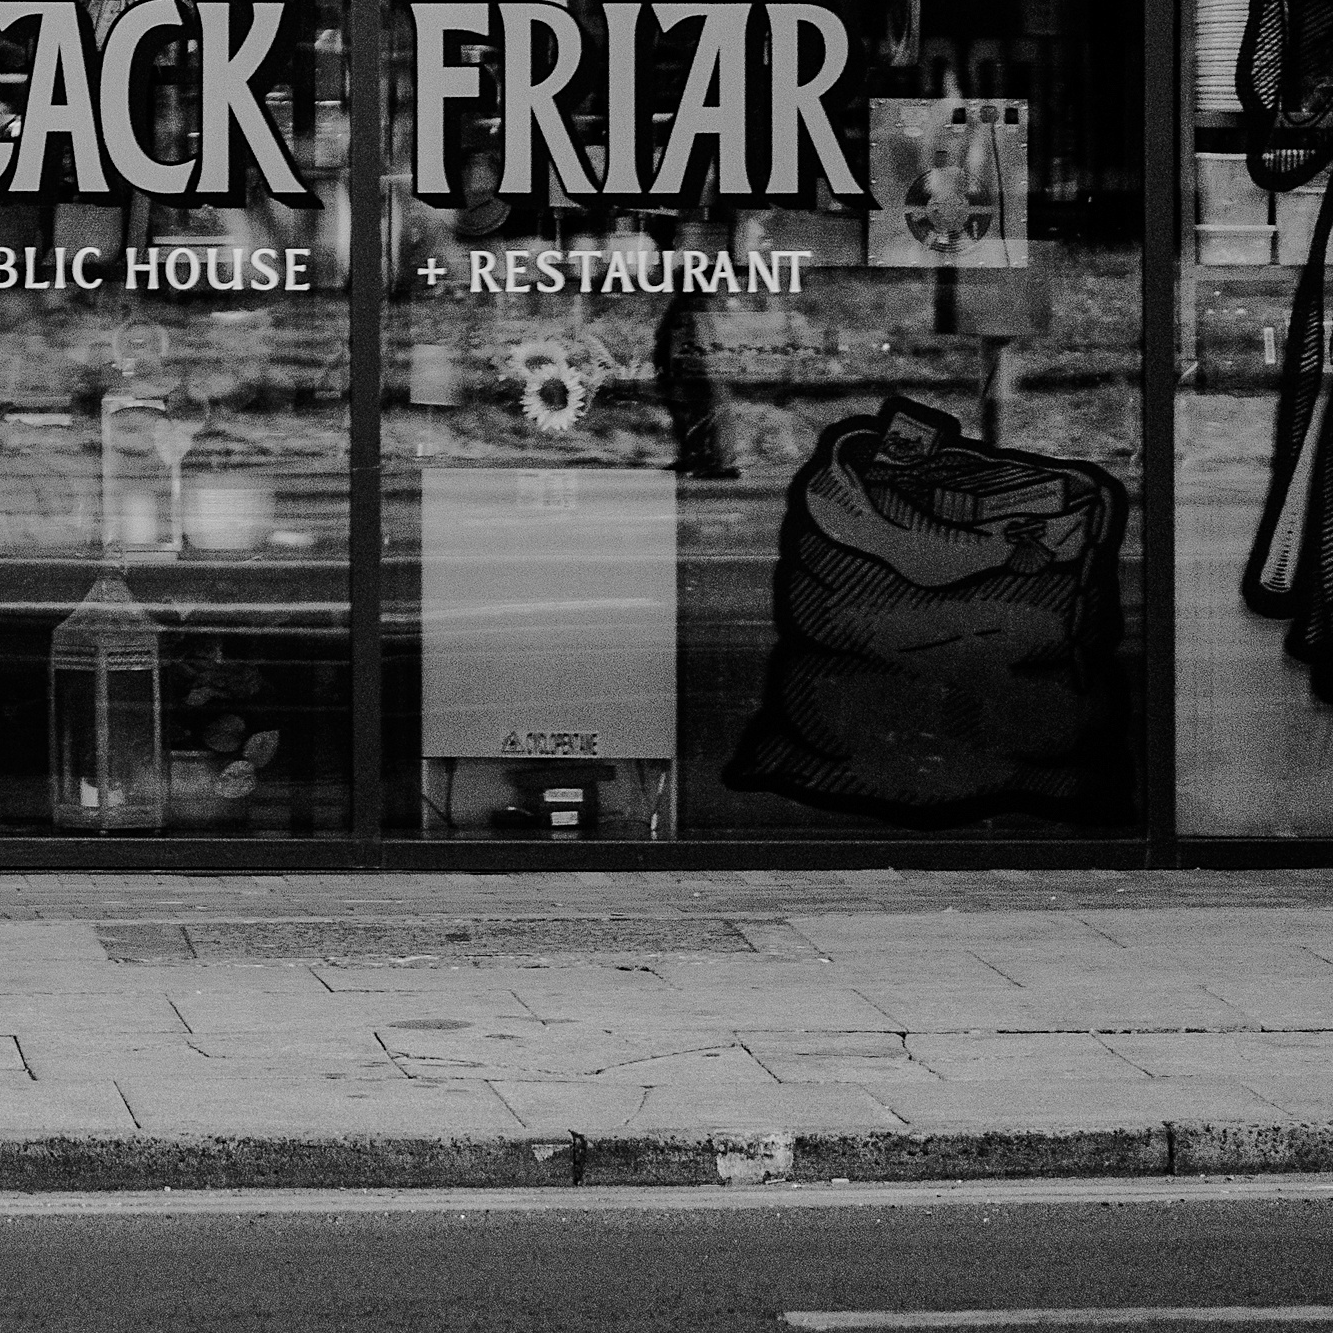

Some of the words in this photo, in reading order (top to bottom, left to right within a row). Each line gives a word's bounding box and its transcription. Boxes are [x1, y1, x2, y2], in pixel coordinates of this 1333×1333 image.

[411, 1, 873, 200] FRIAR
[125, 248, 312, 291] HOUSE
[469, 249, 812, 295] RESTAURANT
